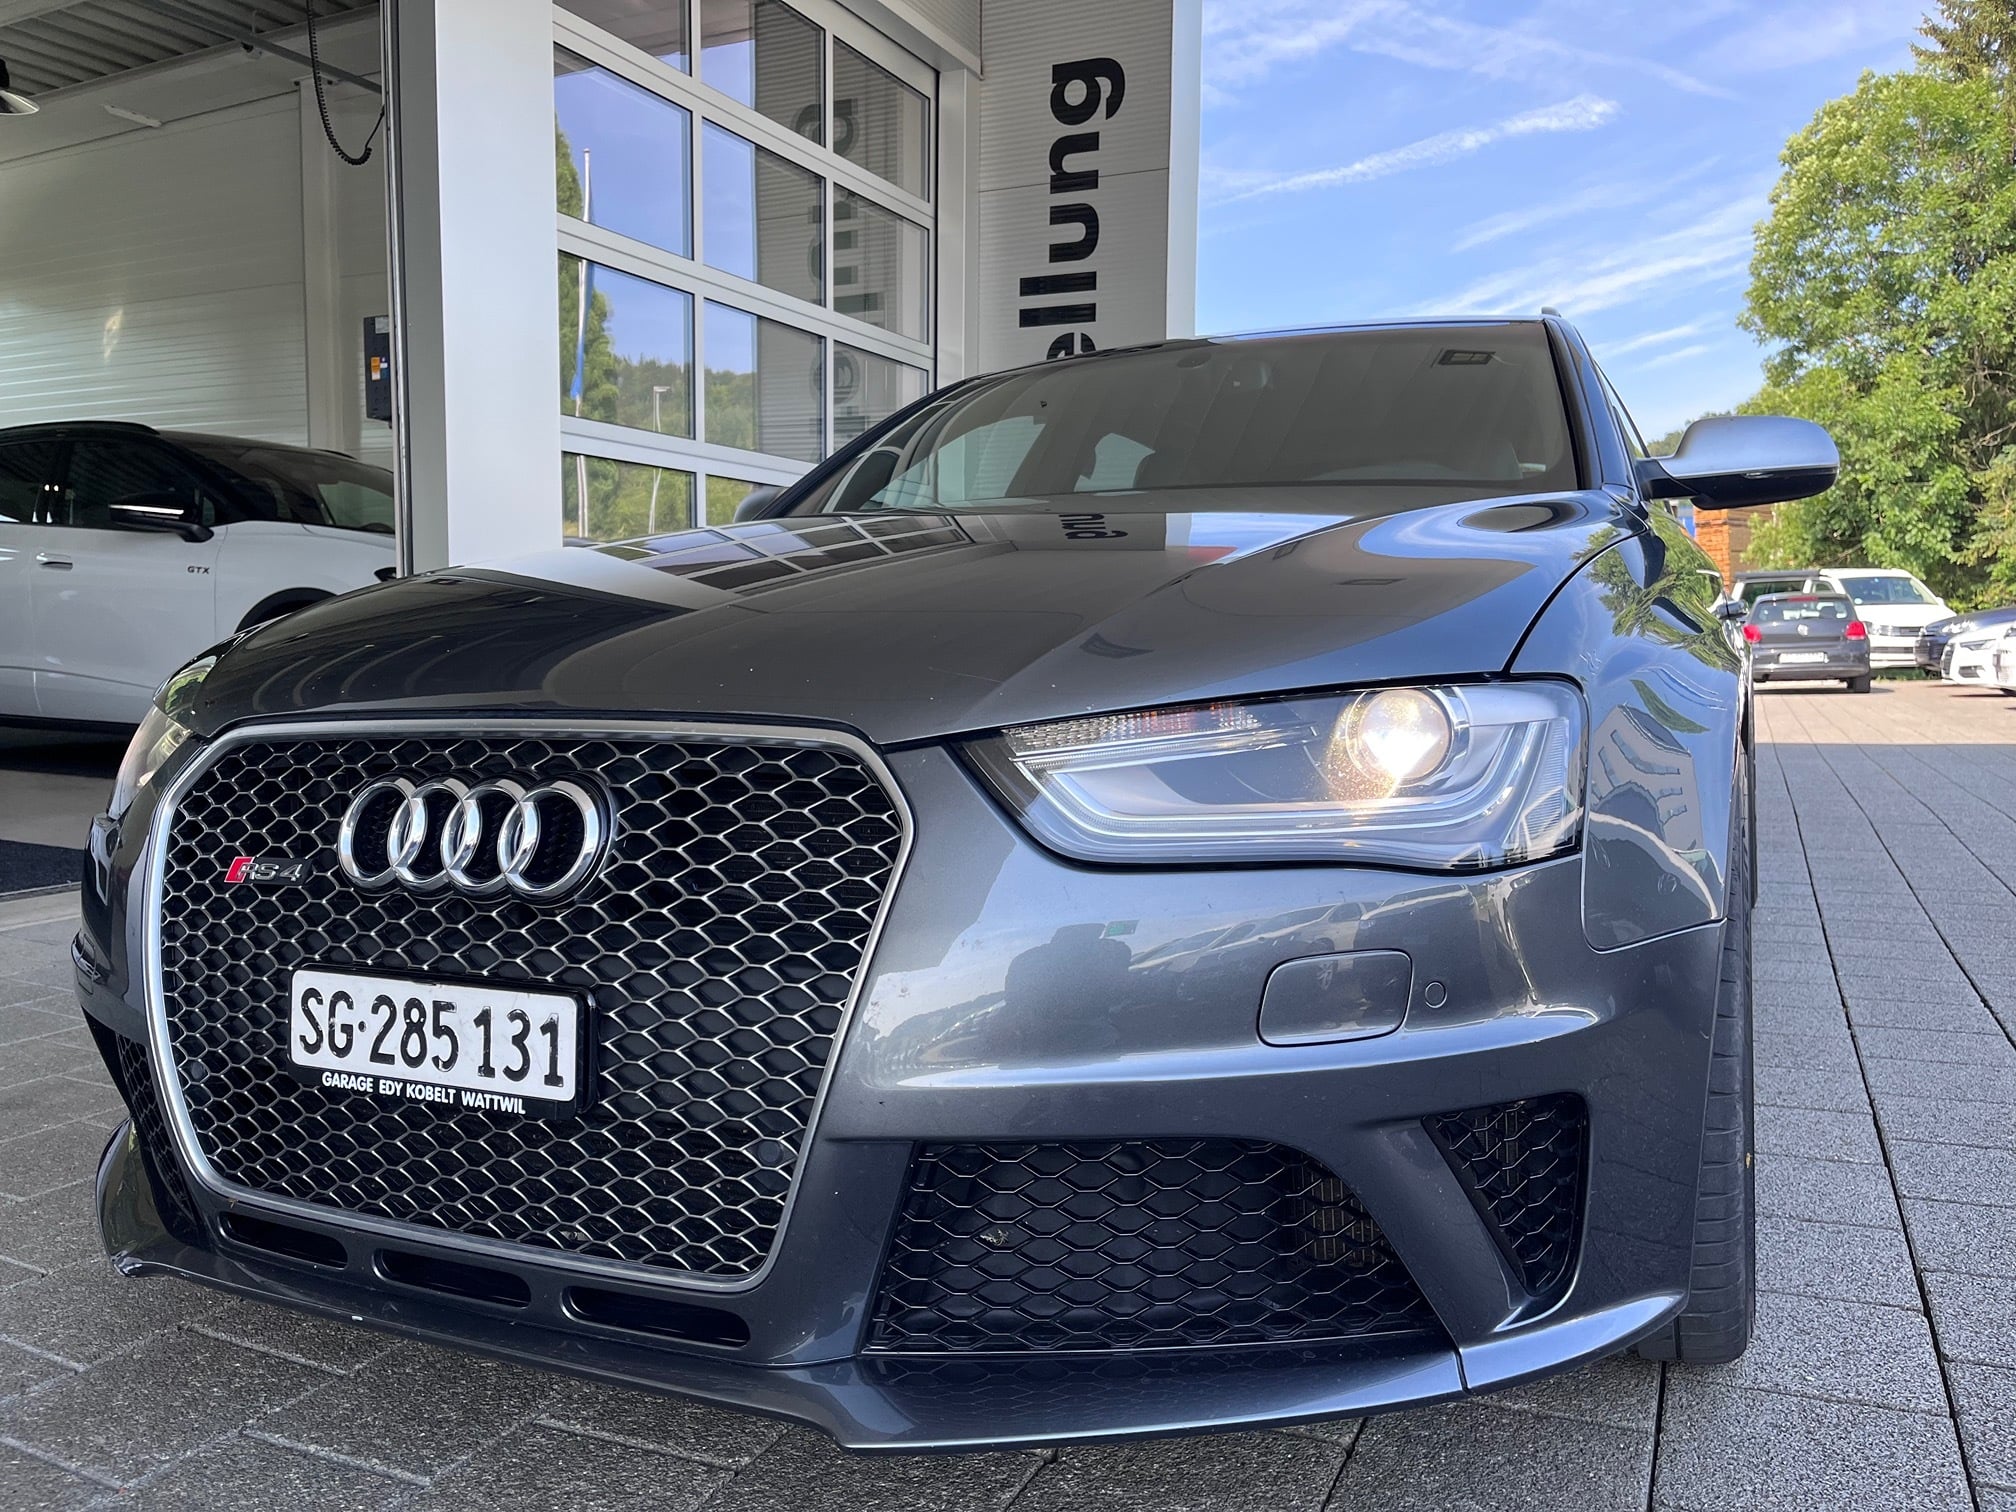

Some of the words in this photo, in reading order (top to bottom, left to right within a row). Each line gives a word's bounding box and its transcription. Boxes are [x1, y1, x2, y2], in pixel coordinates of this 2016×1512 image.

[187, 565, 210, 575] GTX
[322, 1071, 374, 1093] GARAGE
[379, 1079, 403, 1096] EDY
[406, 1083, 455, 1104] KOBELT
[461, 1090, 526, 1115] WATTWIL
